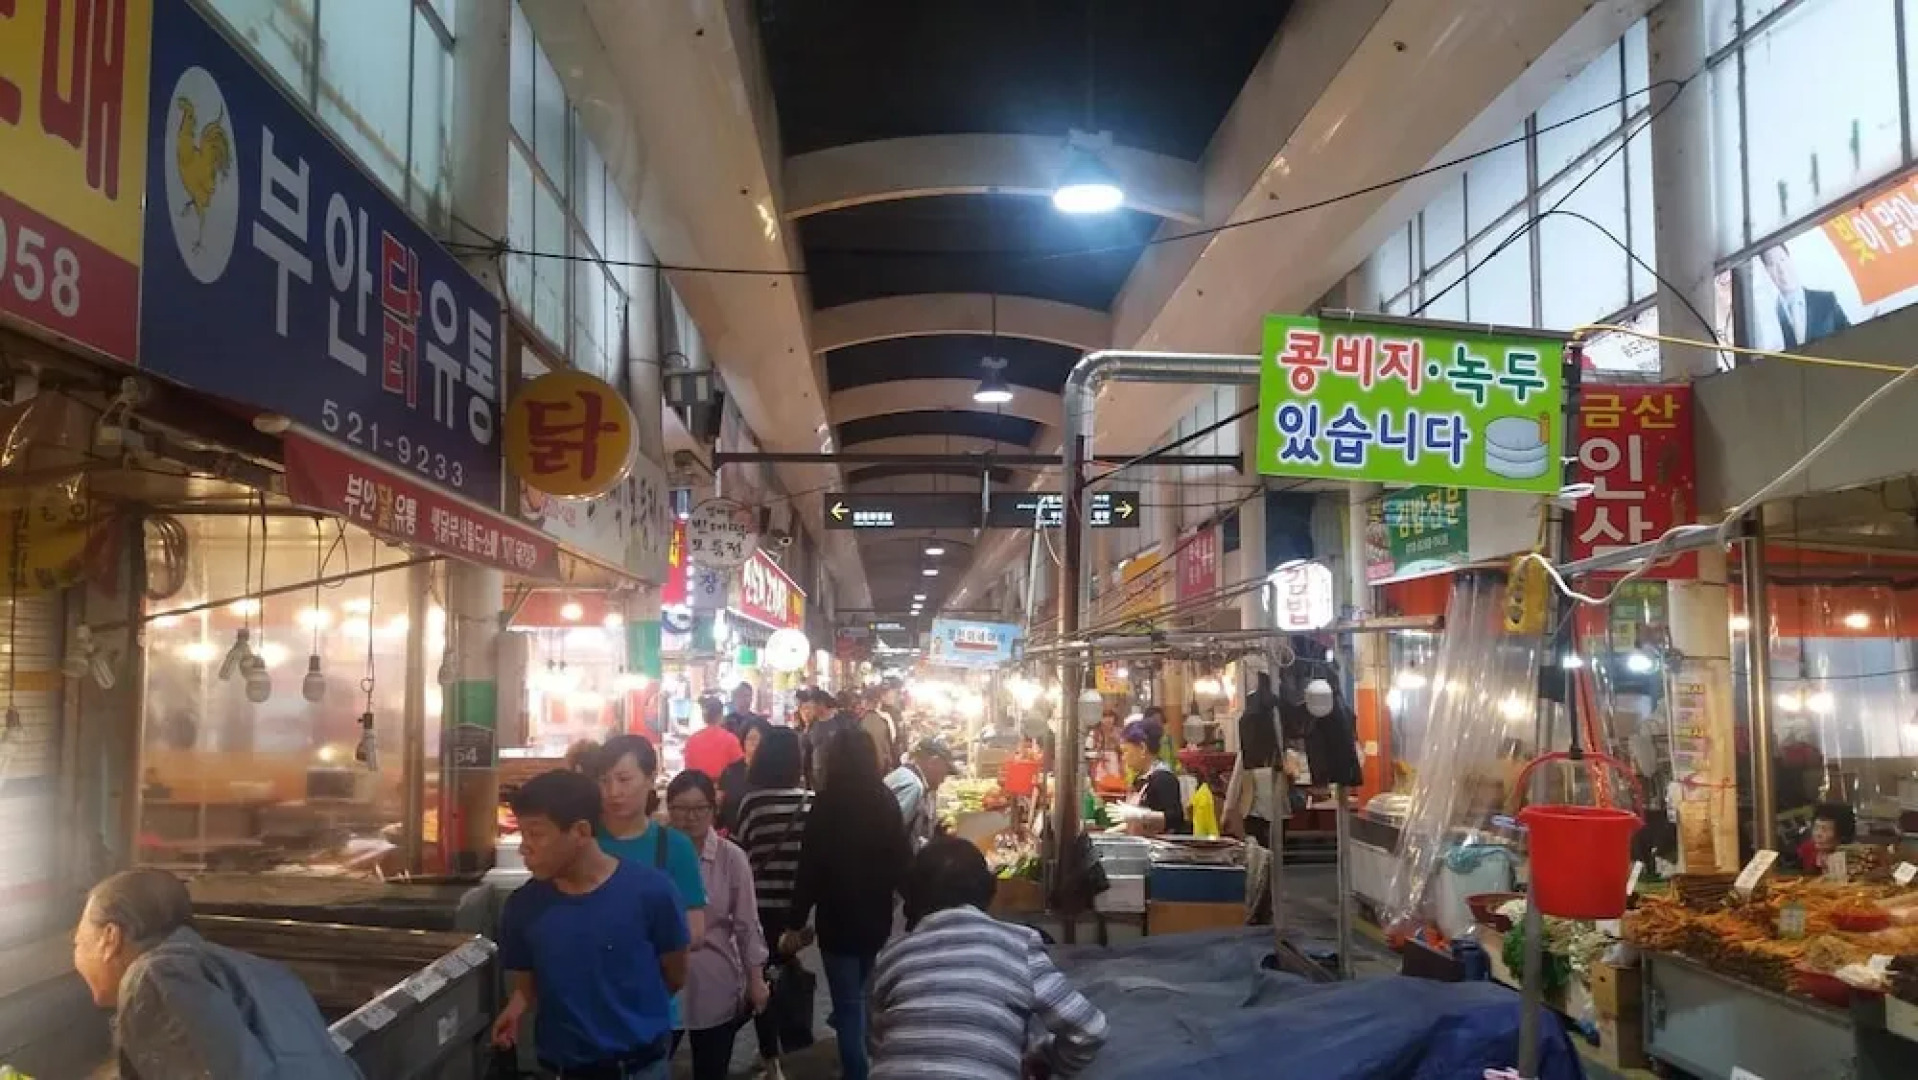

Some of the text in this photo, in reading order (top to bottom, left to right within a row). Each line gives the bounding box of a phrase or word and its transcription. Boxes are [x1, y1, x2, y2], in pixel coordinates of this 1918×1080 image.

[253, 125, 497, 444] 부안닭유통
[320, 399, 465, 487] 521-9233
[525, 390, 621, 479] 닭
[1278, 404, 1468, 465] 있습니다
[1580, 394, 1680, 429] 금산
